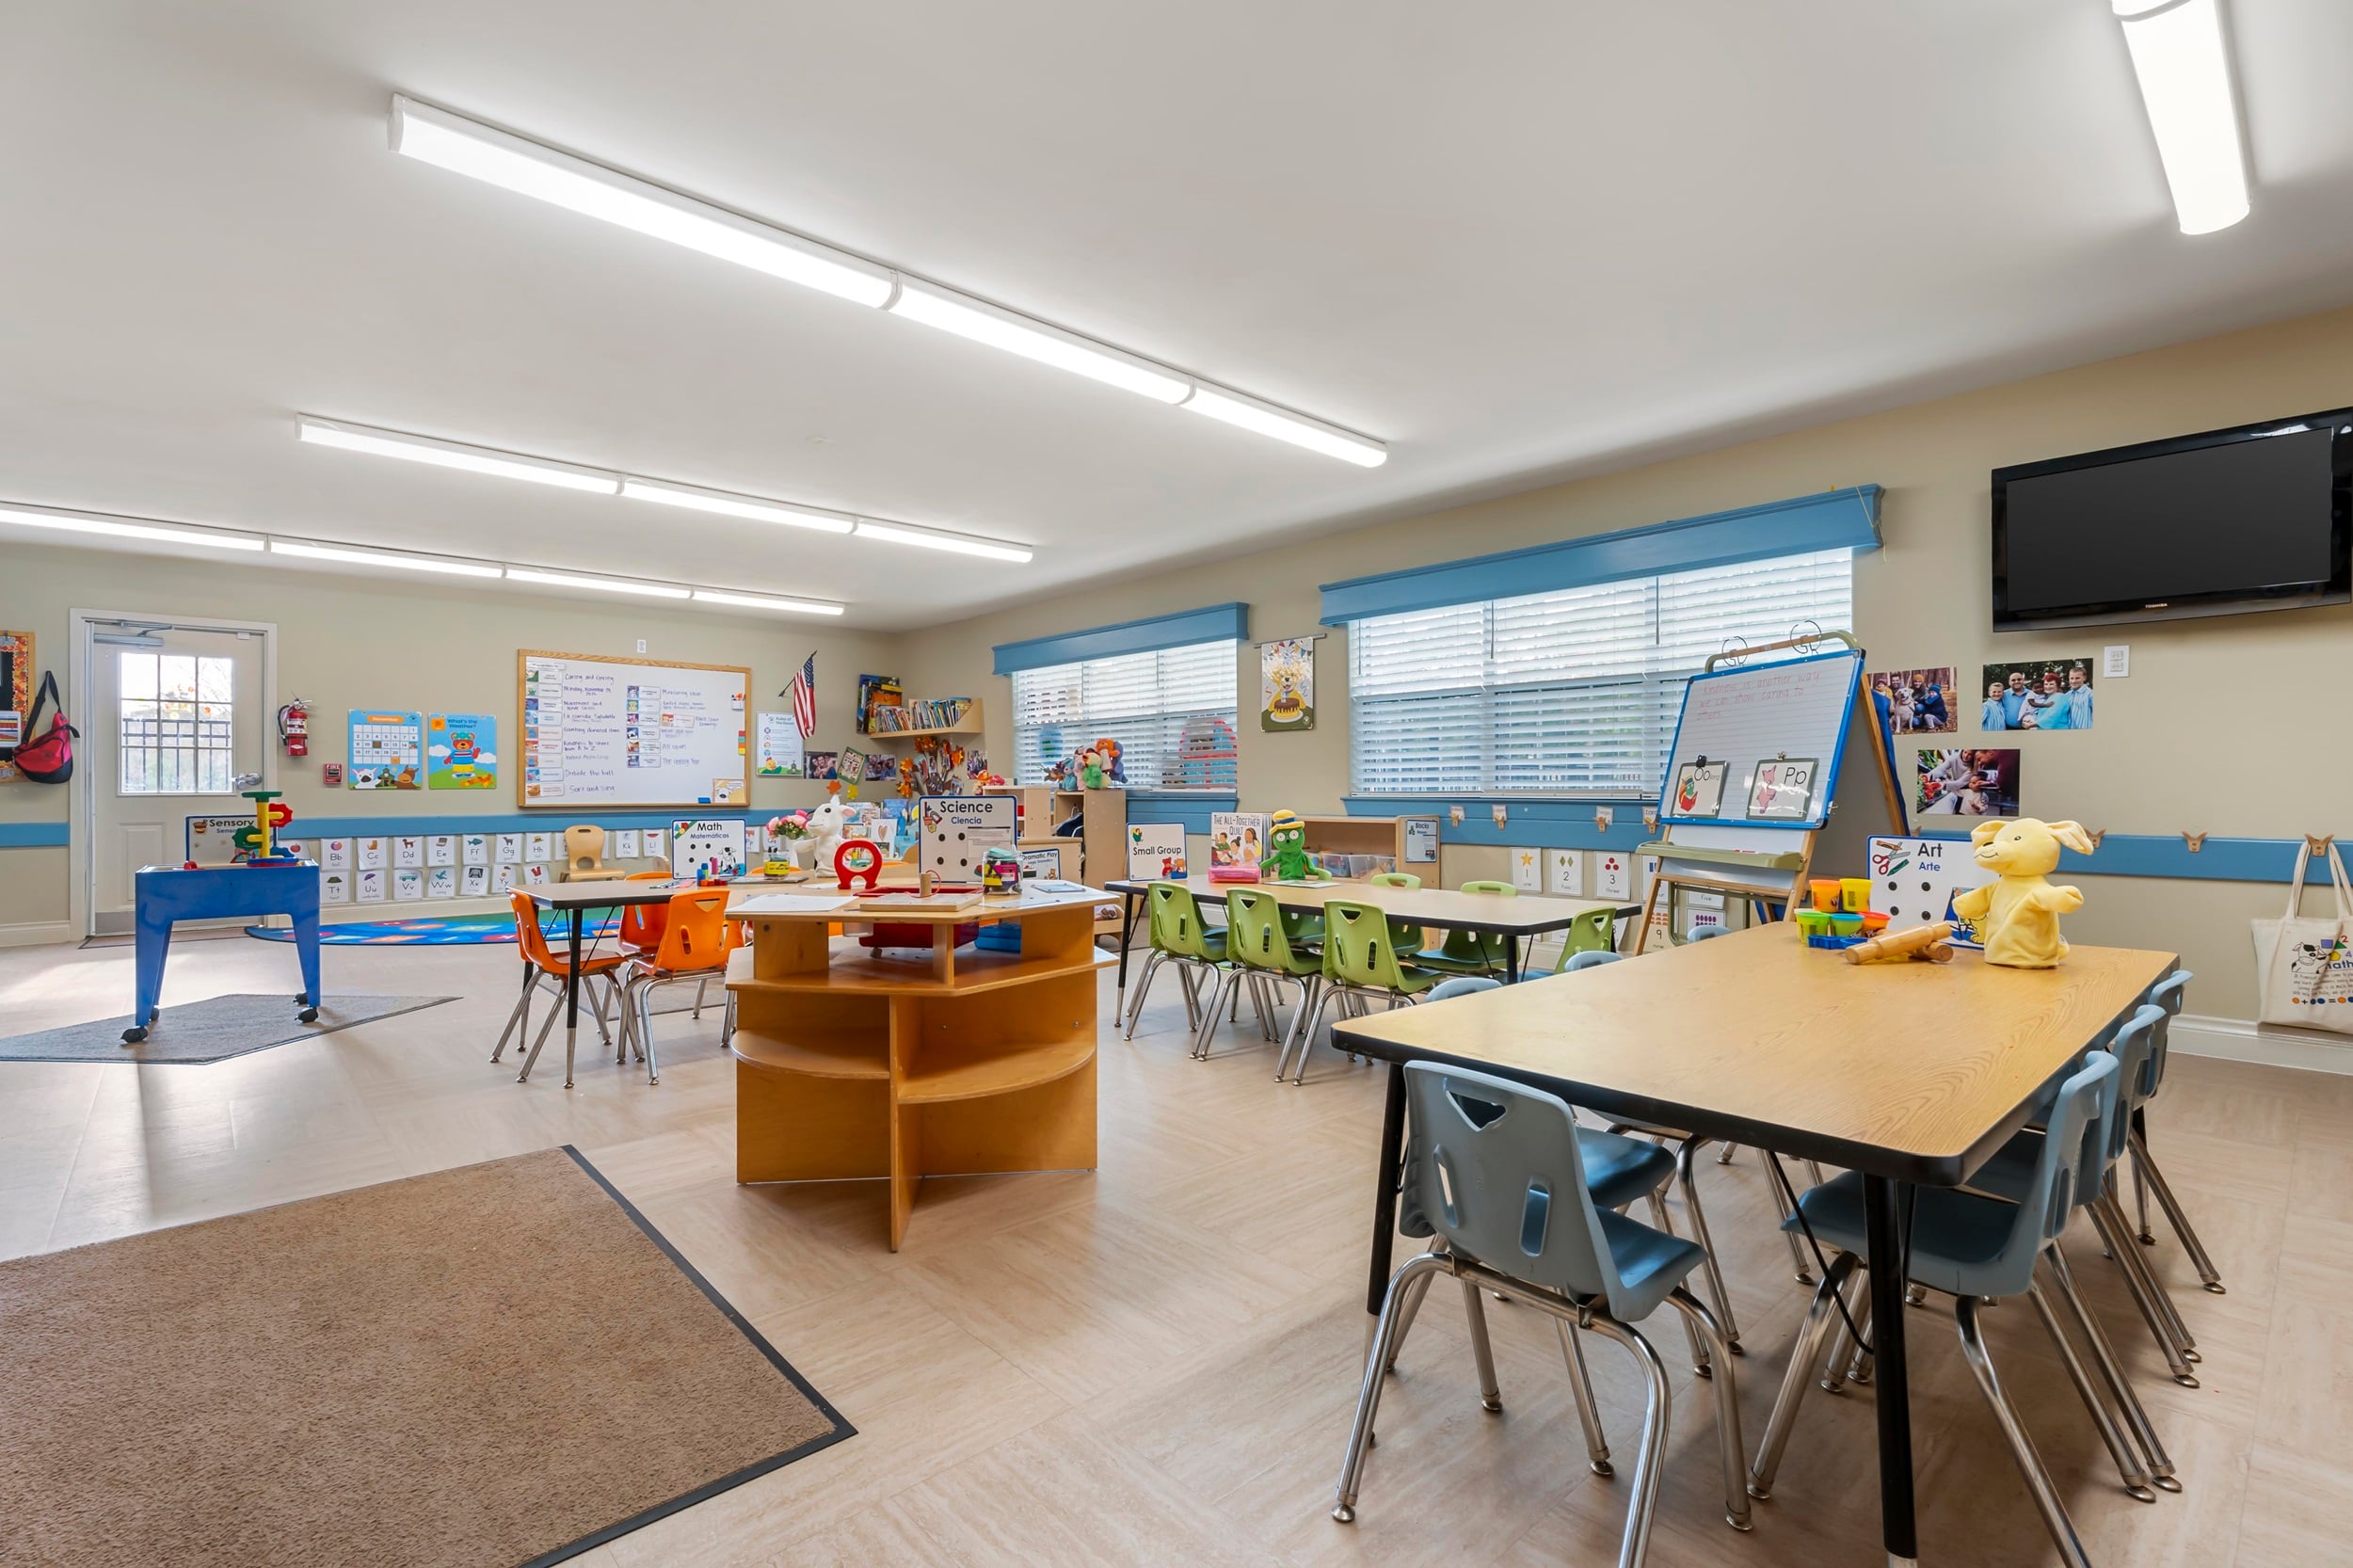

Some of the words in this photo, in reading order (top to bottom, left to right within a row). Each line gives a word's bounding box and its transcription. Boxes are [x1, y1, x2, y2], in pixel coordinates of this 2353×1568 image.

[1746, 680, 1751, 689] is
[1798, 671, 1819, 682] way
[1794, 687, 1804, 696] to
[1784, 767, 1807, 786] Pp
[940, 801, 993, 813] Science
[209, 819, 254, 827] Sensory
[951, 816, 982, 824] Ciencia
[1214, 815, 1223, 824] THE
[1225, 815, 1260, 826] ALL-TOGETHER
[697, 823, 722, 831] Math
[1229, 826, 1243, 836] QUILT
[503, 847, 514, 856] Gg
[1133, 846, 1155, 856] Small
[1158, 846, 1181, 856] Group
[1918, 843, 1943, 857] Art
[1919, 861, 1941, 872] Arte
[1563, 872, 1569, 881] 2
[1609, 874, 1616, 884] 3
[500, 878, 508, 887] Yy
[1657, 930, 1662, 939] 9
